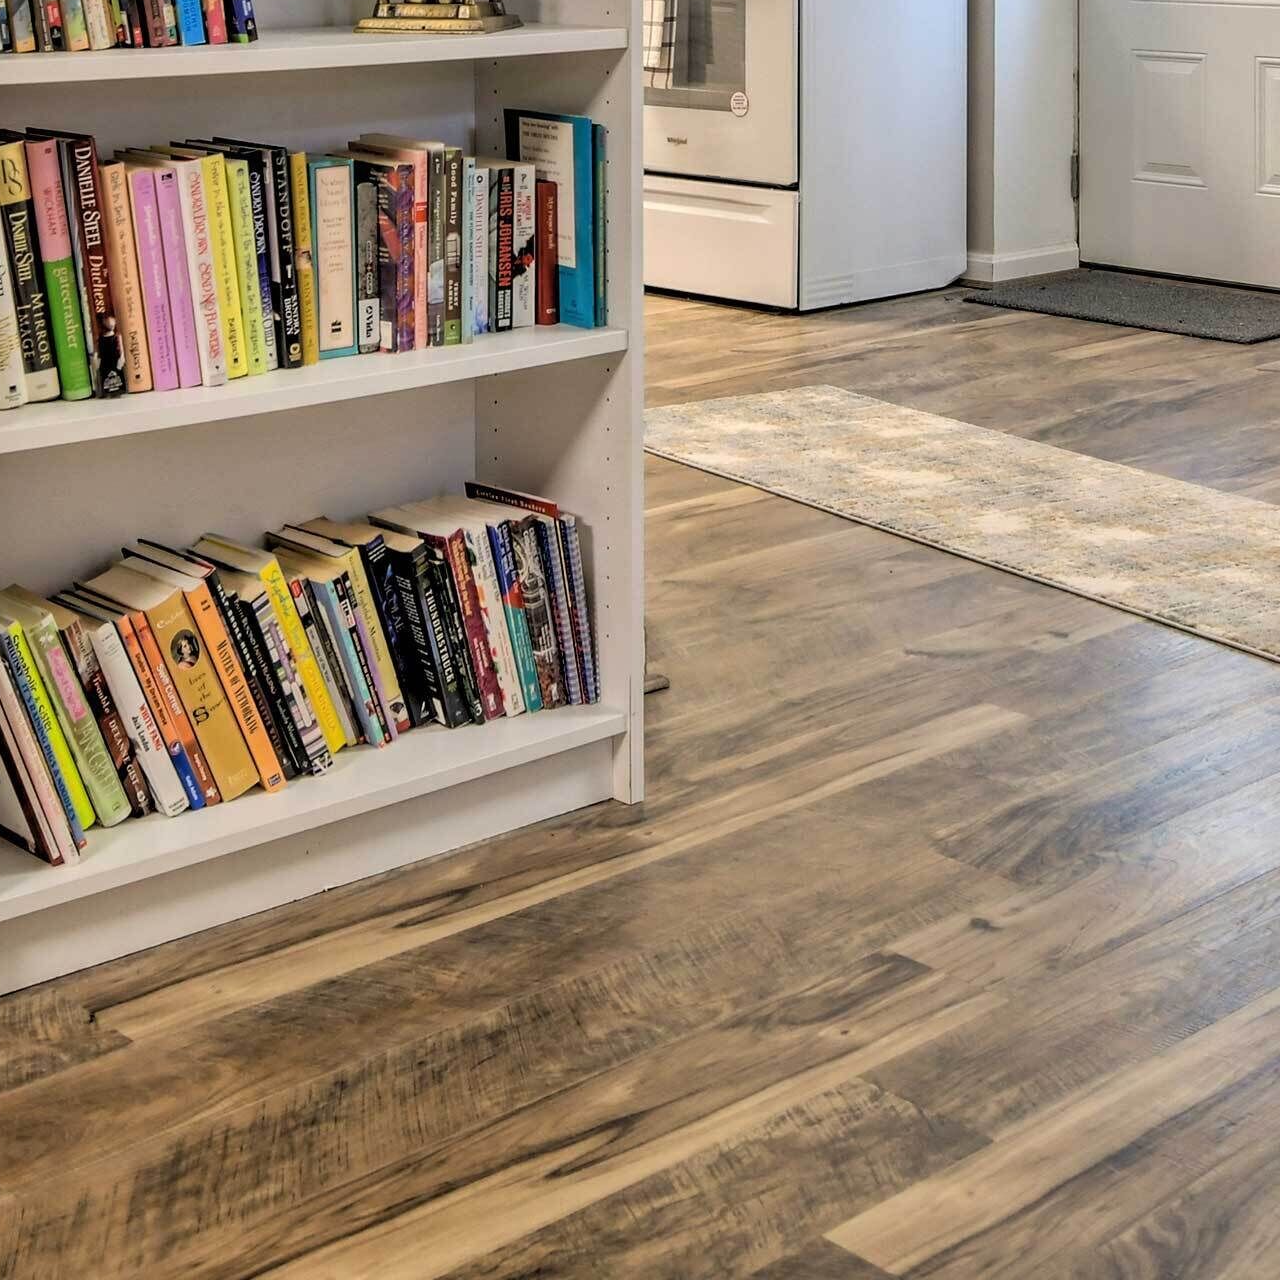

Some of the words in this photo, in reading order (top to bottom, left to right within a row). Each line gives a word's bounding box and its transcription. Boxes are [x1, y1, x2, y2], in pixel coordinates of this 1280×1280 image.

[73, 146, 98, 209] DANIELLE
[188, 170, 204, 213] SANDRA
[249, 171, 264, 213] SANDRA
[449, 162, 458, 188] Good
[276, 156, 291, 255] STANDOFF
[448, 190, 458, 225] Family
[499, 189, 513, 217] IRIS
[8, 210, 32, 255] DANIELLE
[81, 209, 104, 250] STEEL
[192, 211, 207, 256] BROWN
[252, 214, 267, 256] BROWN
[15, 252, 36, 286] STEEL
[497, 220, 511, 287] JOHANSEN
[88, 253, 111, 315] Duchess
[198, 261, 212, 294] SEND
[31, 292, 52, 365] MIRROR
[54, 266, 79, 351] gatecrasher
[283, 298, 294, 336] BROWN
[289, 294, 300, 336] SANDRA
[364, 314, 374, 339] Vida
[17, 303, 38, 360] IMAGE
[204, 311, 220, 360] FLOWERS
[215, 583, 232, 609] HALF
[224, 608, 244, 642] BROKE
[238, 640, 259, 678] HORSES
[423, 588, 456, 684] THUNDERSTRUCK
[214, 638, 240, 680] MASTERS
[228, 674, 243, 690] OF
[90, 673, 114, 716] Trouble
[154, 662, 172, 687] Swift
[163, 683, 184, 718] Current
[130, 714, 143, 732] Jack
[137, 729, 153, 753] London
[137, 702, 155, 730] WHITE
[147, 726, 164, 753] FANG
[125, 762, 141, 787] GIST
